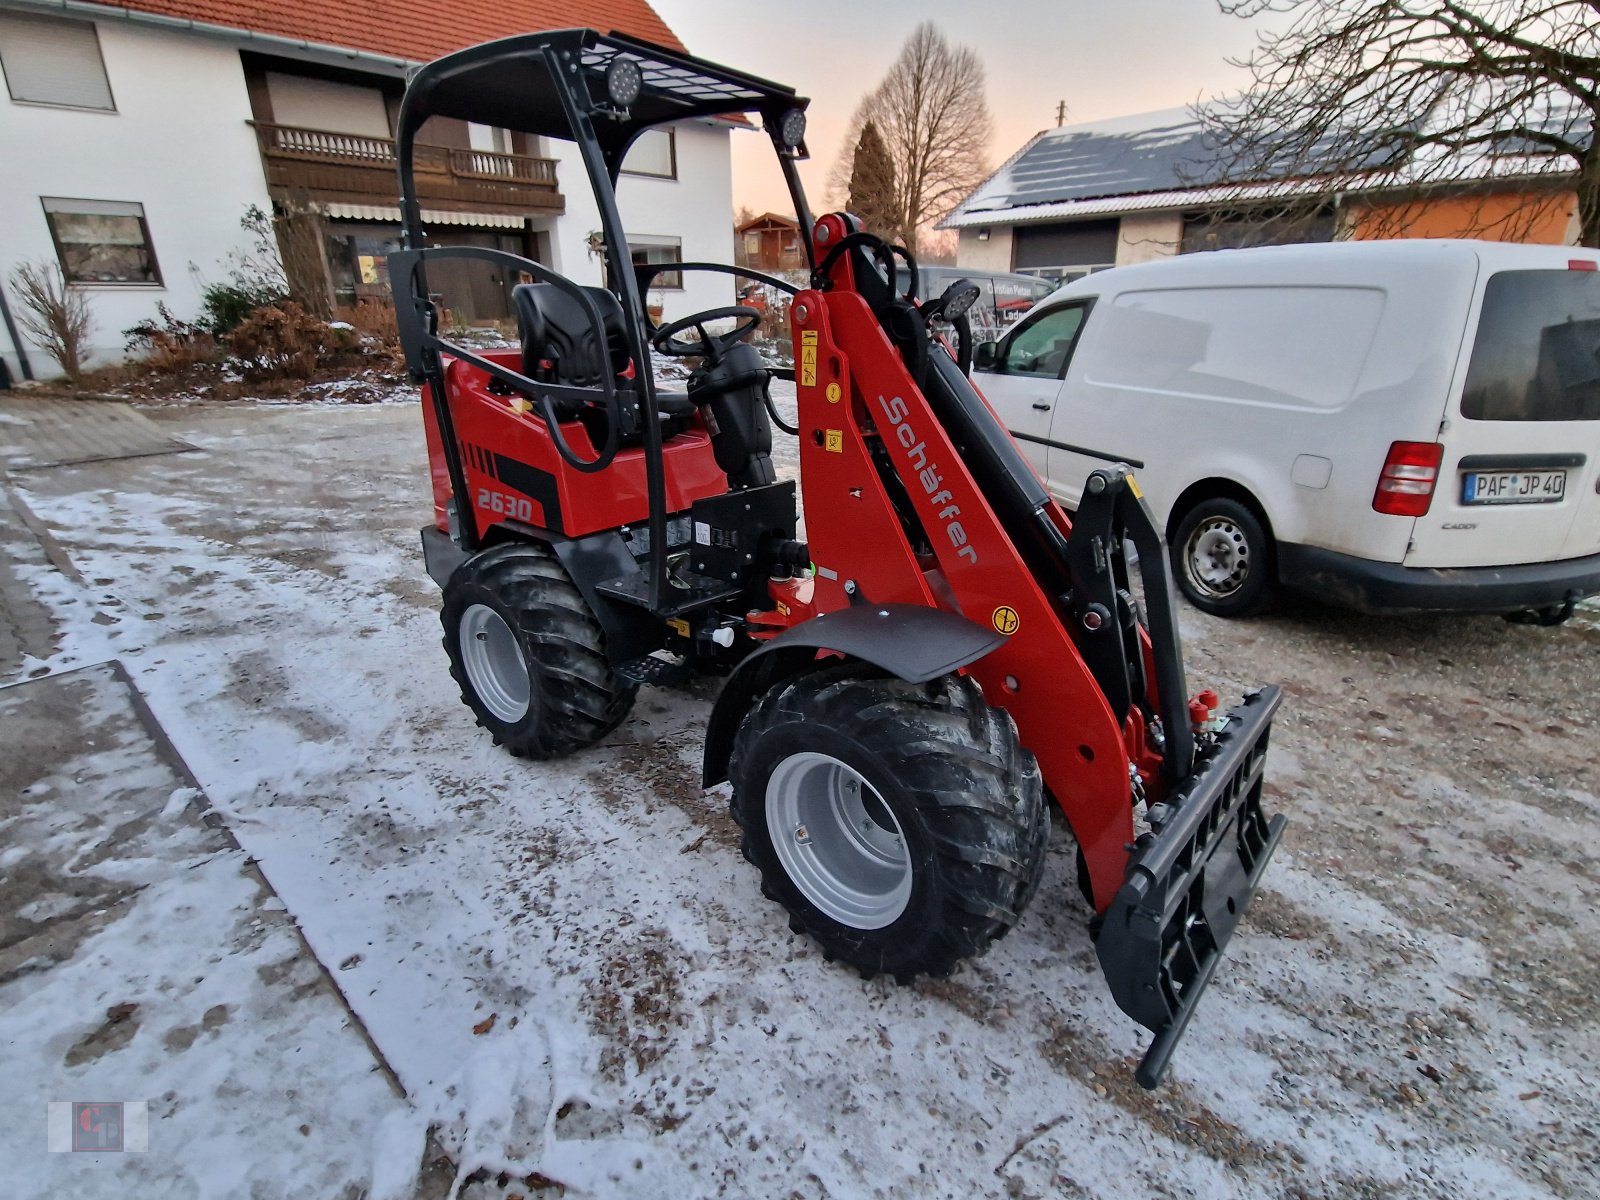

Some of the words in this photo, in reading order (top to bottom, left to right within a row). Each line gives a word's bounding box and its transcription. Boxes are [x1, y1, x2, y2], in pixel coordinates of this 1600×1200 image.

[878, 394, 978, 565] Schäffer
[1477, 476, 1509, 496] PAF
[1519, 474, 1541, 495] JP
[1542, 474, 1563, 495] 40
[477, 487, 533, 522] 2630
